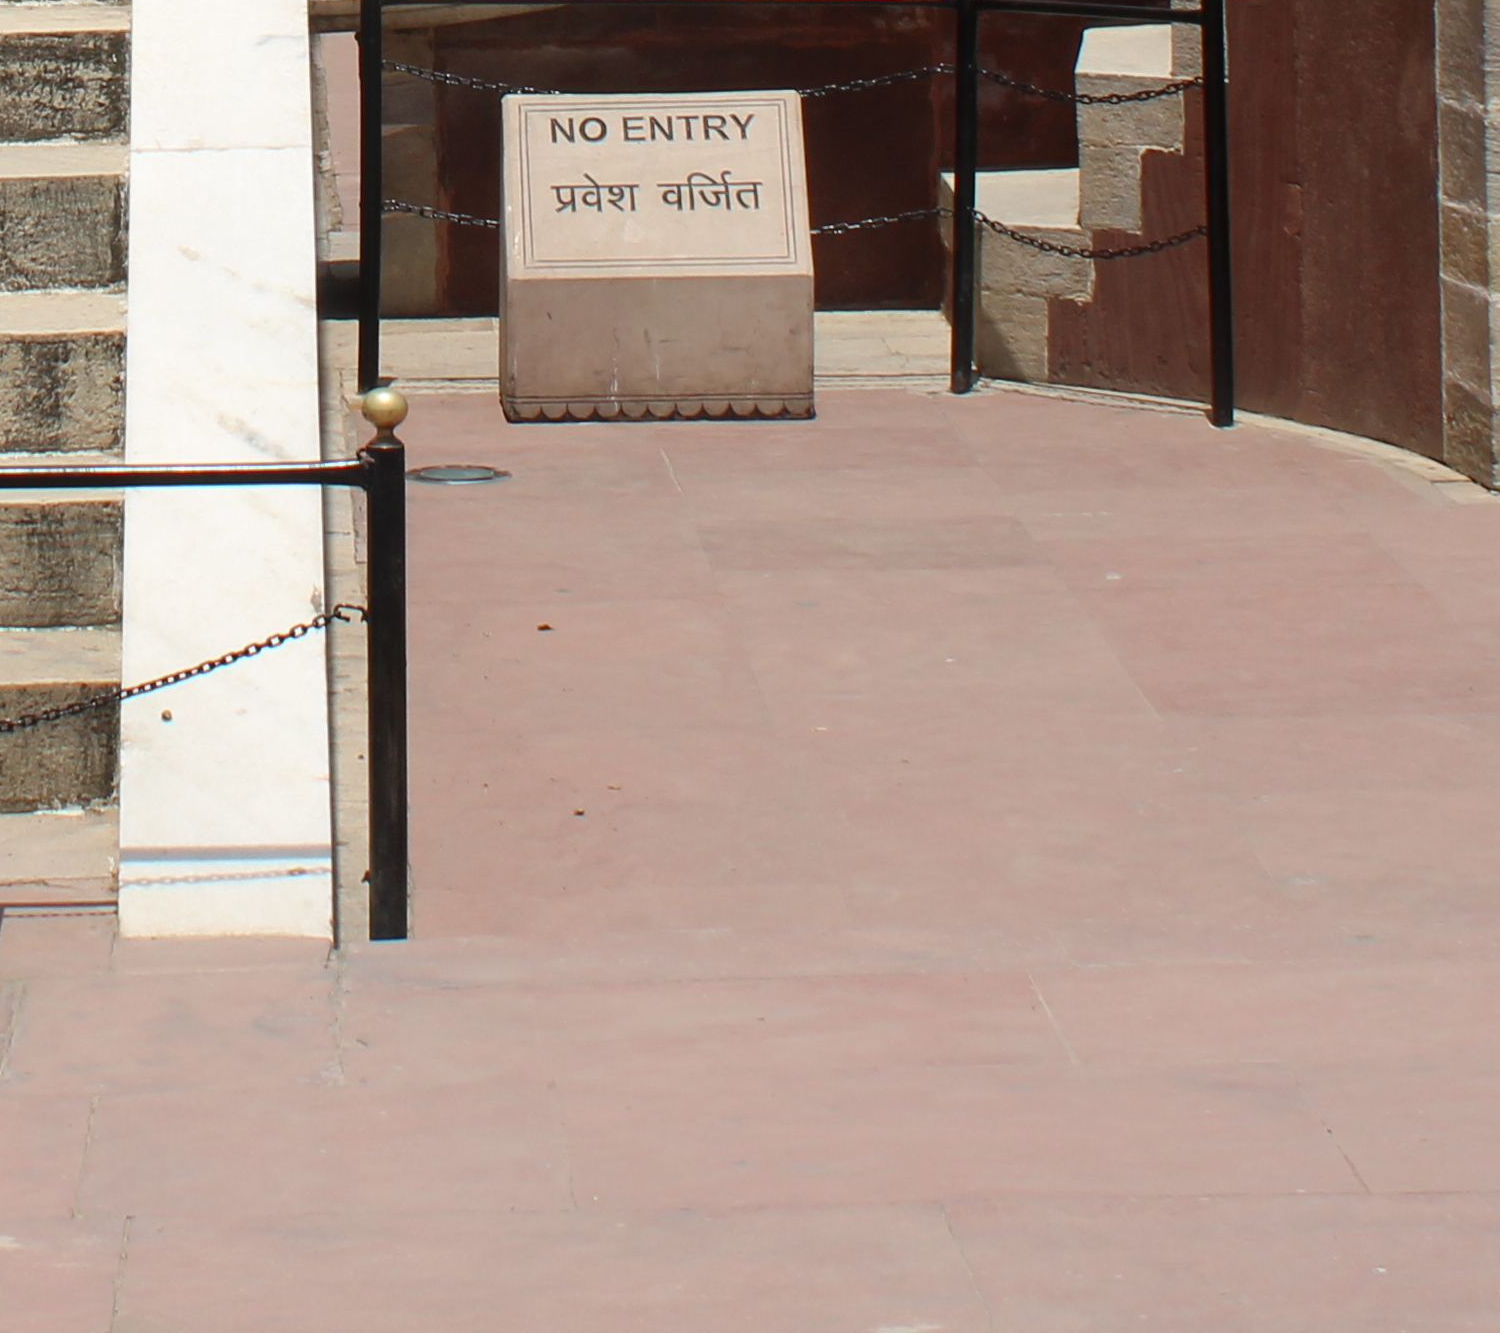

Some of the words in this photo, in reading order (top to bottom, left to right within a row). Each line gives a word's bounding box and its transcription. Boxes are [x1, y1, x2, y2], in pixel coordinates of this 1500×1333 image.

[549, 117, 608, 144] NO
[622, 113, 755, 142] ENTRY
[550, 173, 640, 213] प्रवेश
[657, 170, 763, 211] वर्जित
